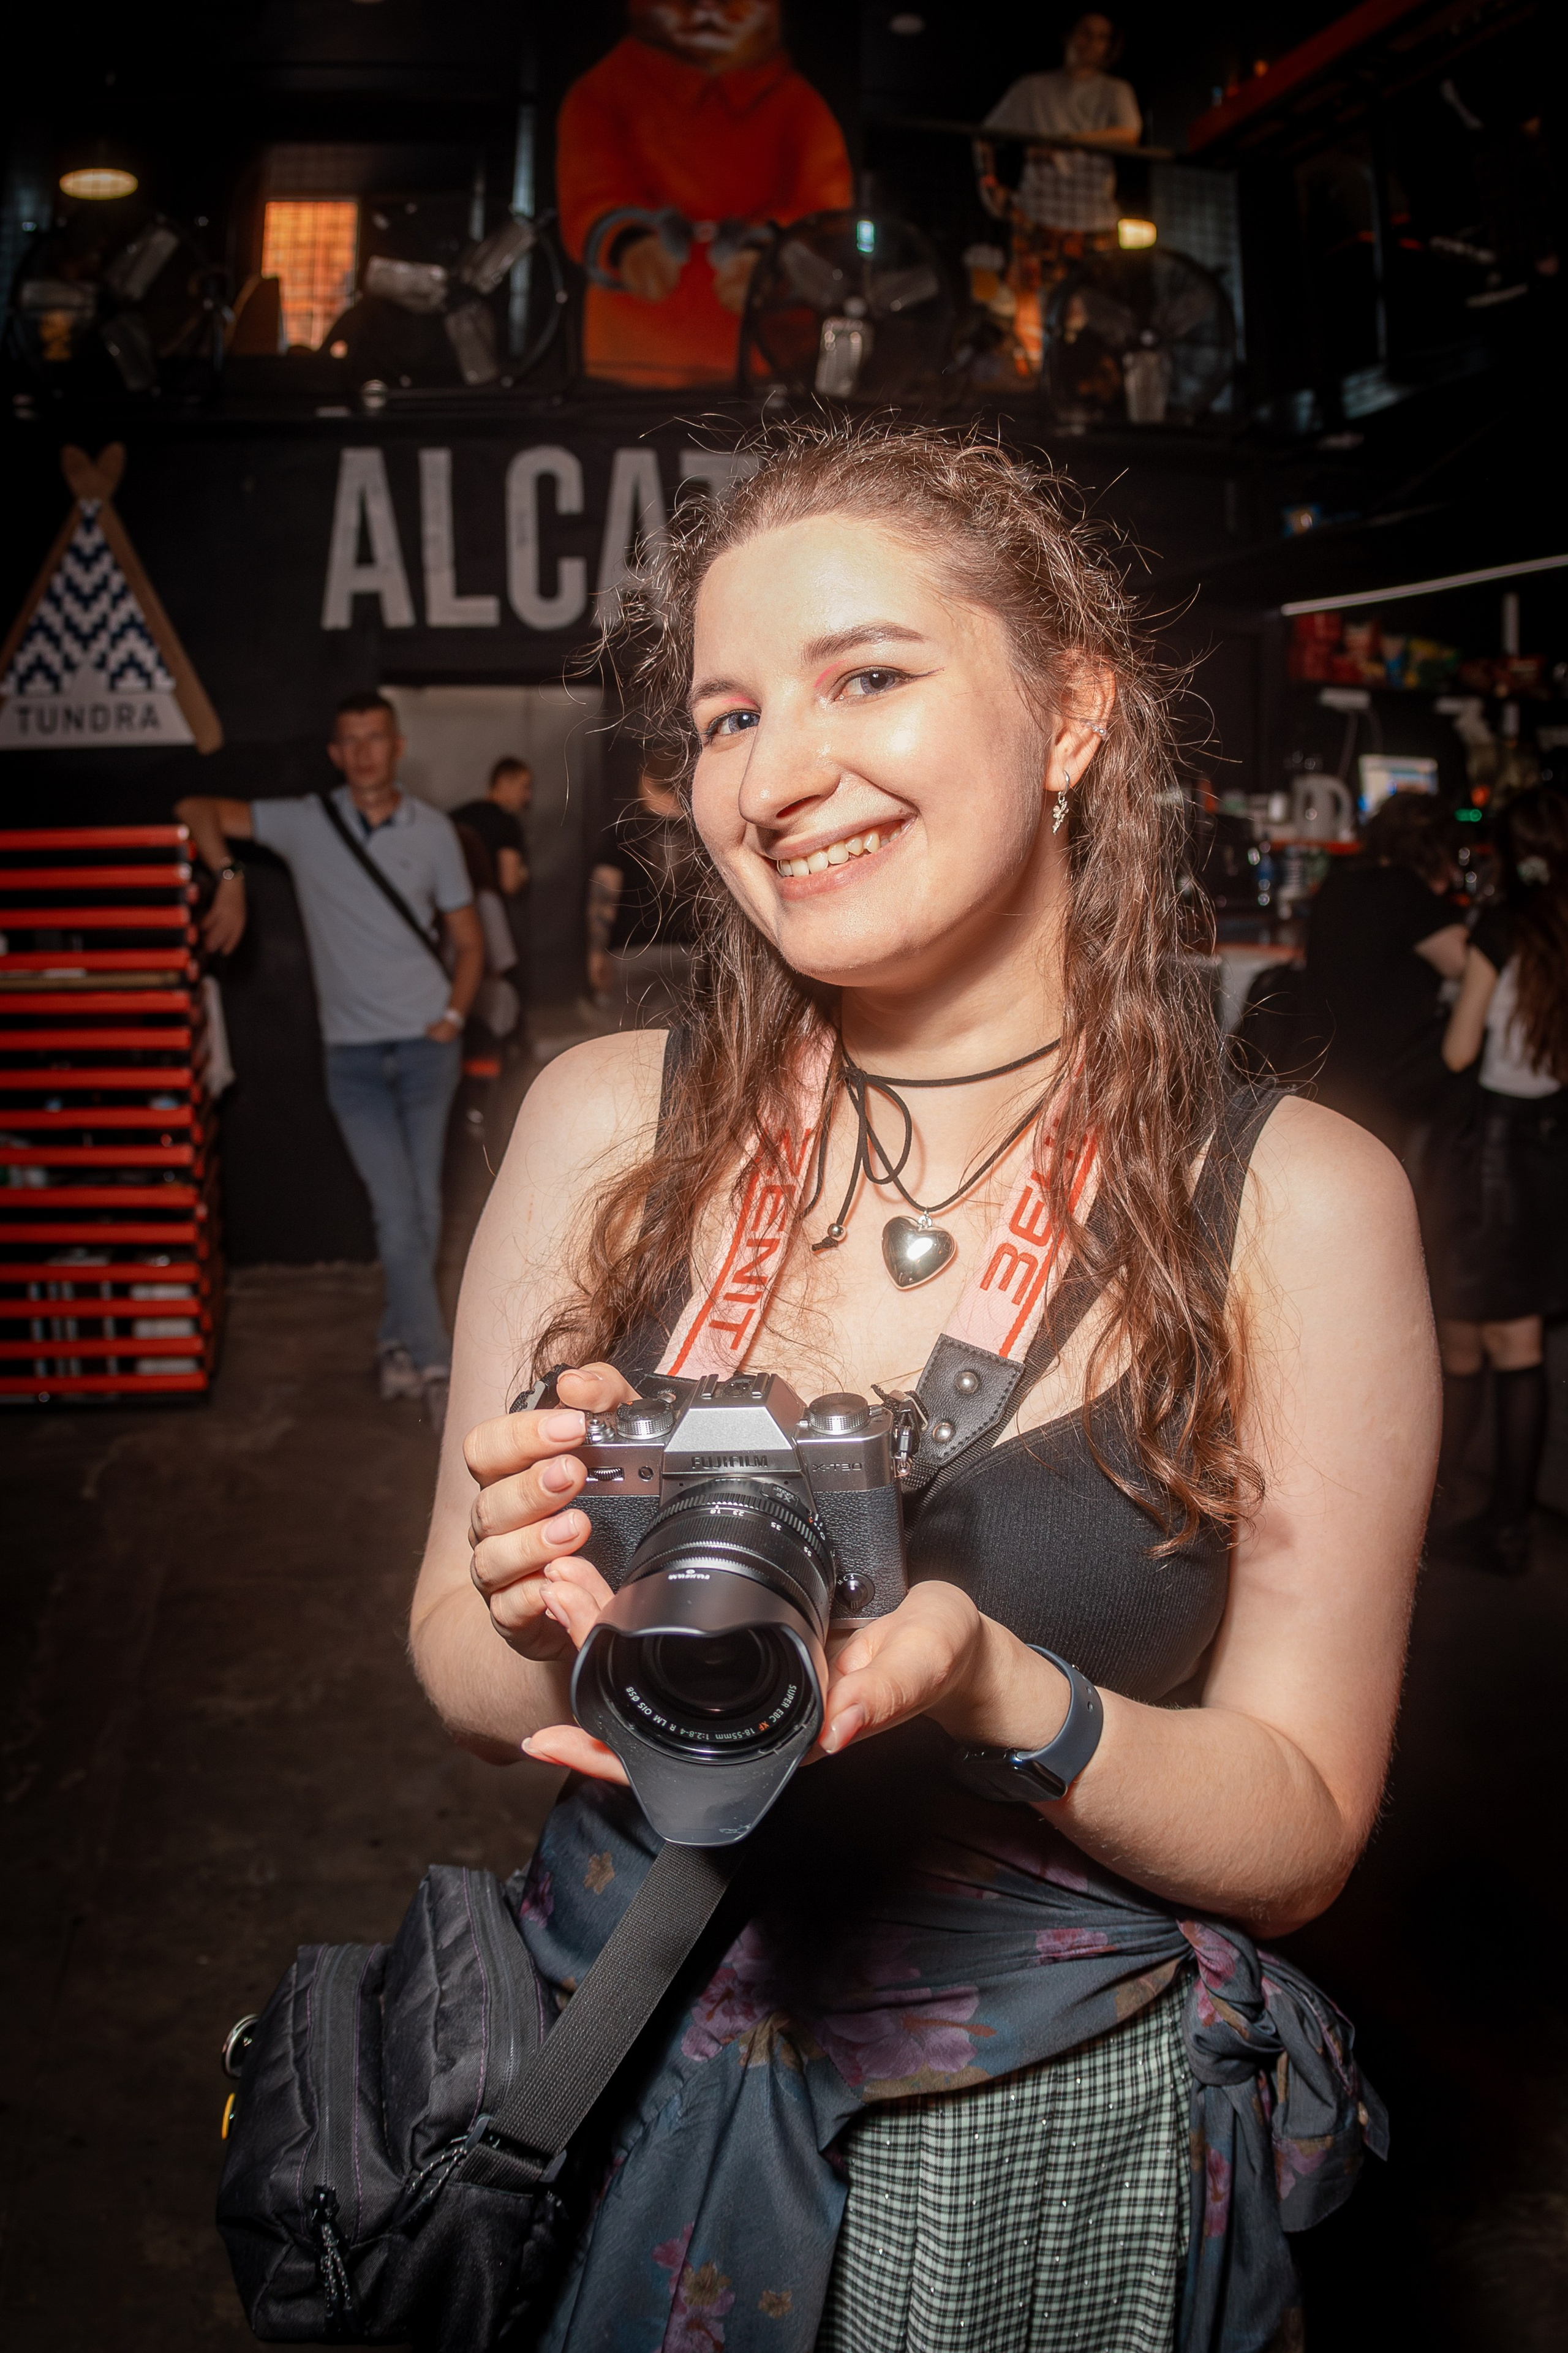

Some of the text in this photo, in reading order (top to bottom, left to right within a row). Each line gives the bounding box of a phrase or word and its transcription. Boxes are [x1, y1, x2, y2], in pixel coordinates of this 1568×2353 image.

[17, 703, 161, 735] TUNDRA
[691, 1454, 768, 1469] FUJIFILM
[812, 1462, 862, 1472] X-T30
[771, 1521, 782, 1531] 35
[804, 1546, 812, 1557] 55
[781, 1684, 797, 1708] SUPER
[638, 1702, 652, 1715] OIS
[653, 1715, 667, 1726] LM
[769, 1709, 784, 1723] EBC
[758, 1721, 770, 1731] XF
[680, 1728, 710, 1740] 1:2.8-4
[715, 1728, 755, 1740] 18-55mm
